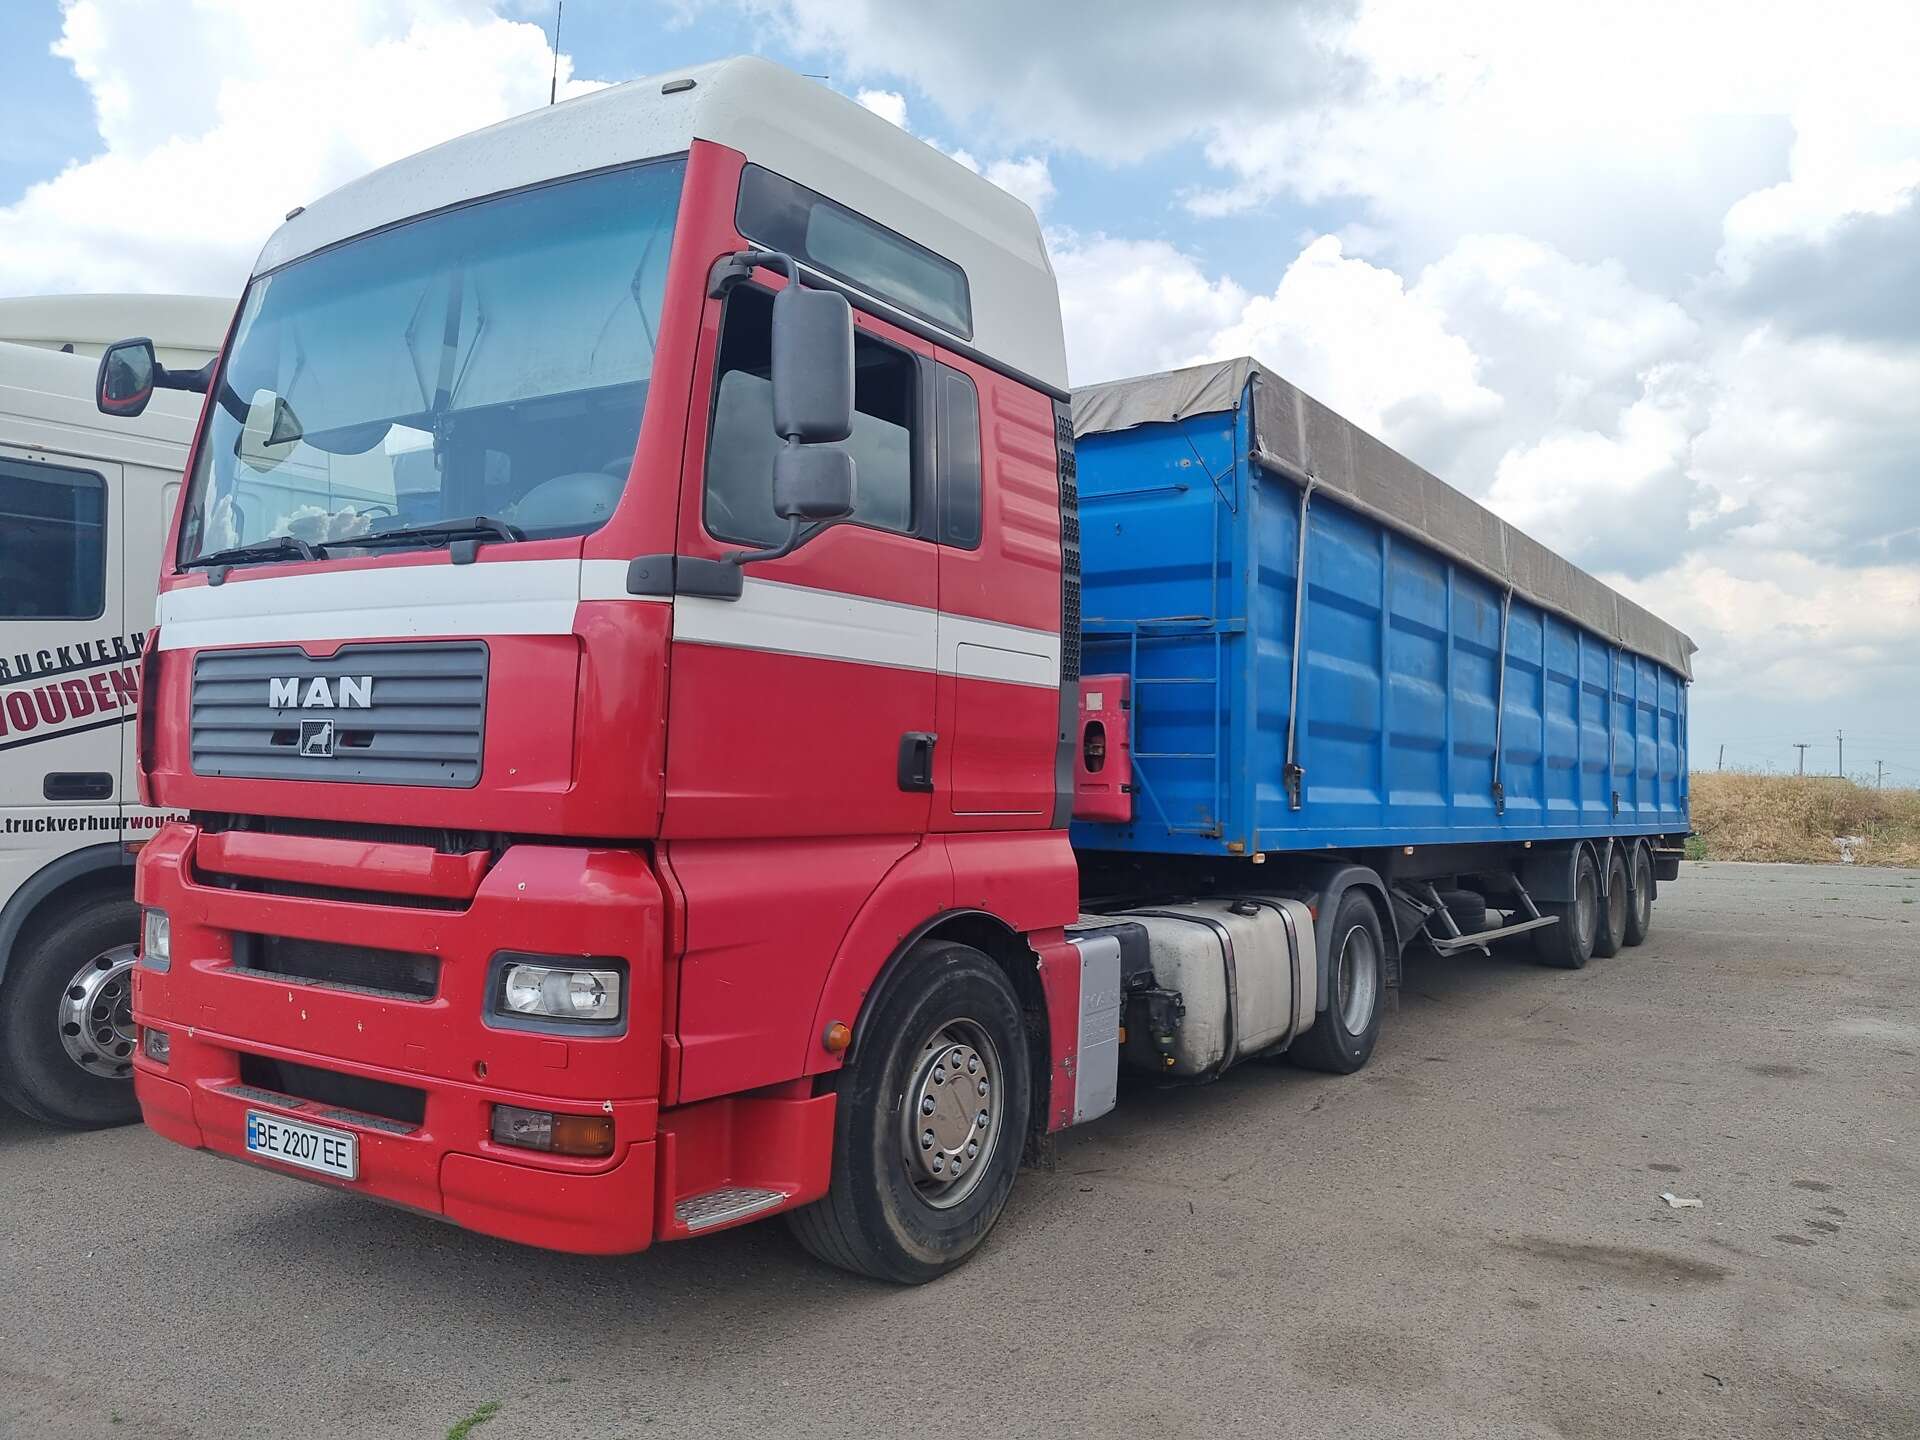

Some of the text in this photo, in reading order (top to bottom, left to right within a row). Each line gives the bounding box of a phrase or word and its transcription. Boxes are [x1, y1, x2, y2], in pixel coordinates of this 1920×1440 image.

[0, 665, 141, 736] OUDEN
[269, 676, 372, 708] MAN
[257, 1122, 347, 1168] BE 2207 EE
